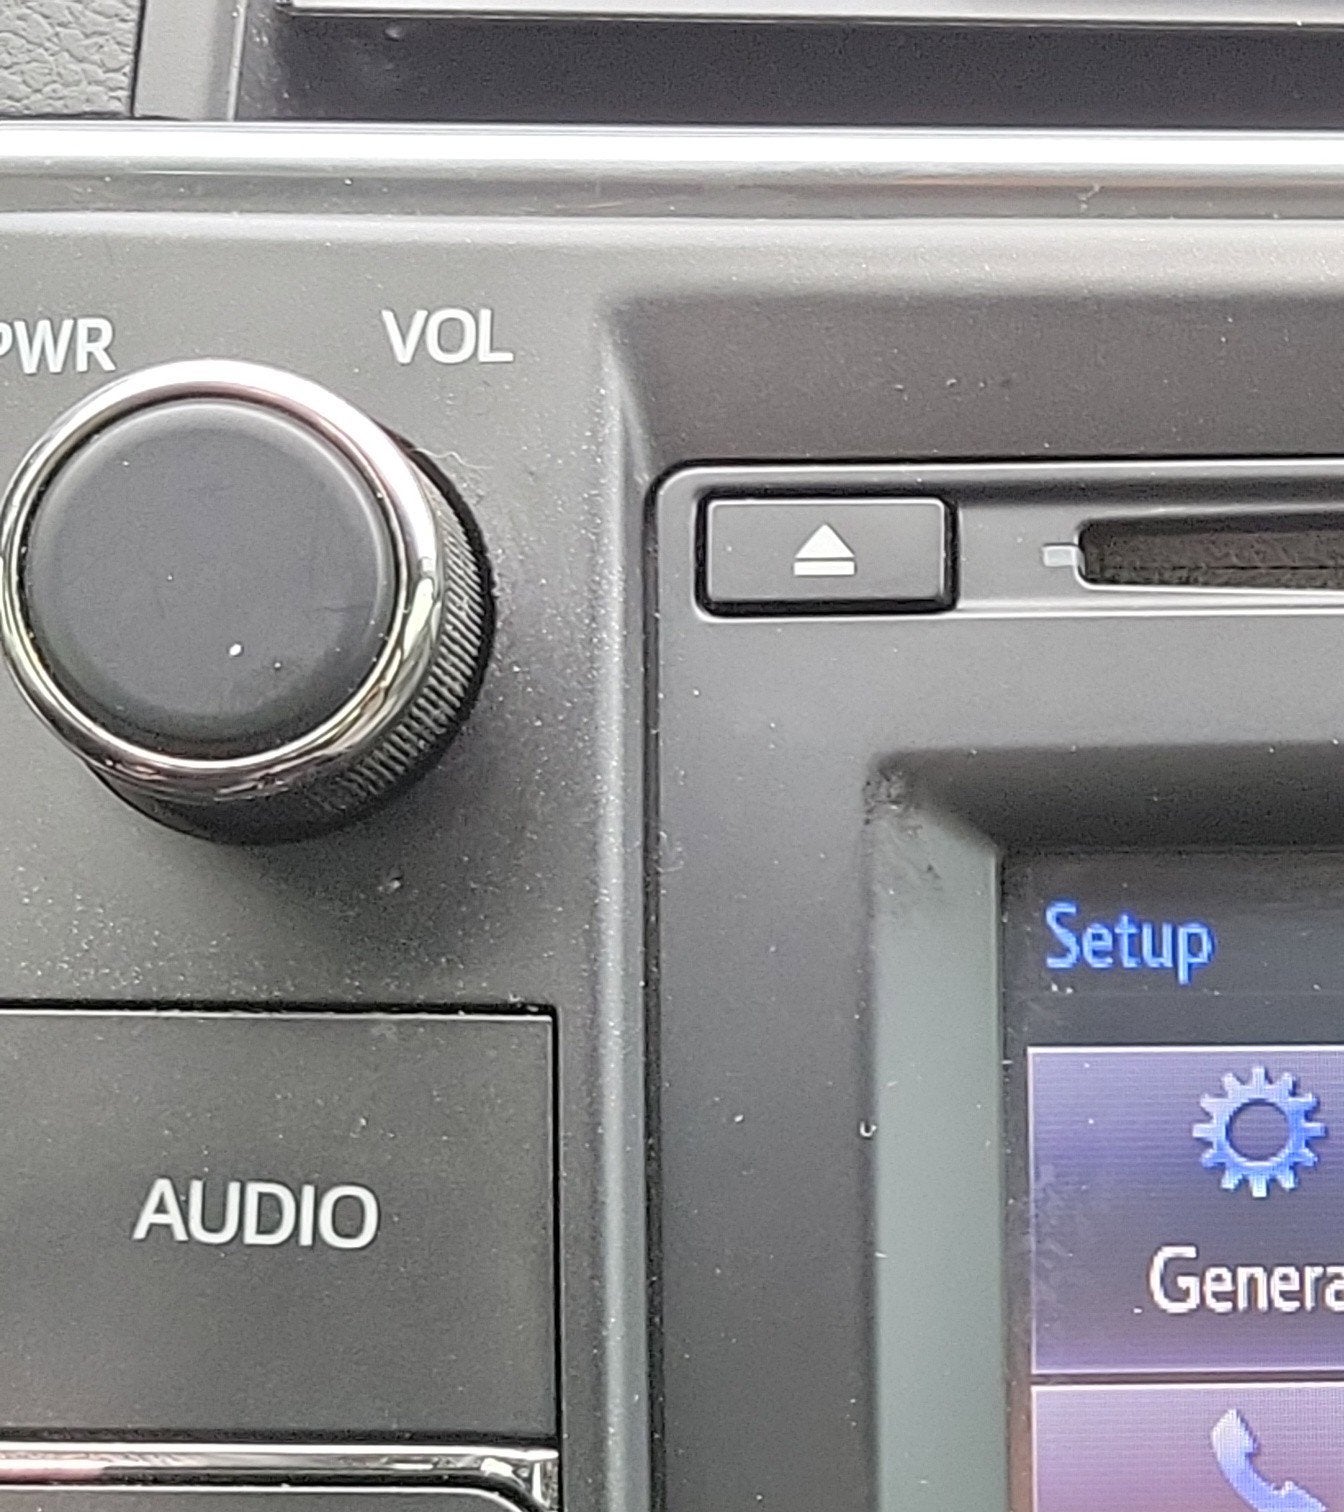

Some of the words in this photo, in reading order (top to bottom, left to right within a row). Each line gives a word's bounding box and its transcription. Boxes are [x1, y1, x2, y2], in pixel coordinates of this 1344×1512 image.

[381, 308, 514, 364] VOL
[1044, 901, 1215, 984] Setup
[132, 1178, 381, 1249] AUDIO
